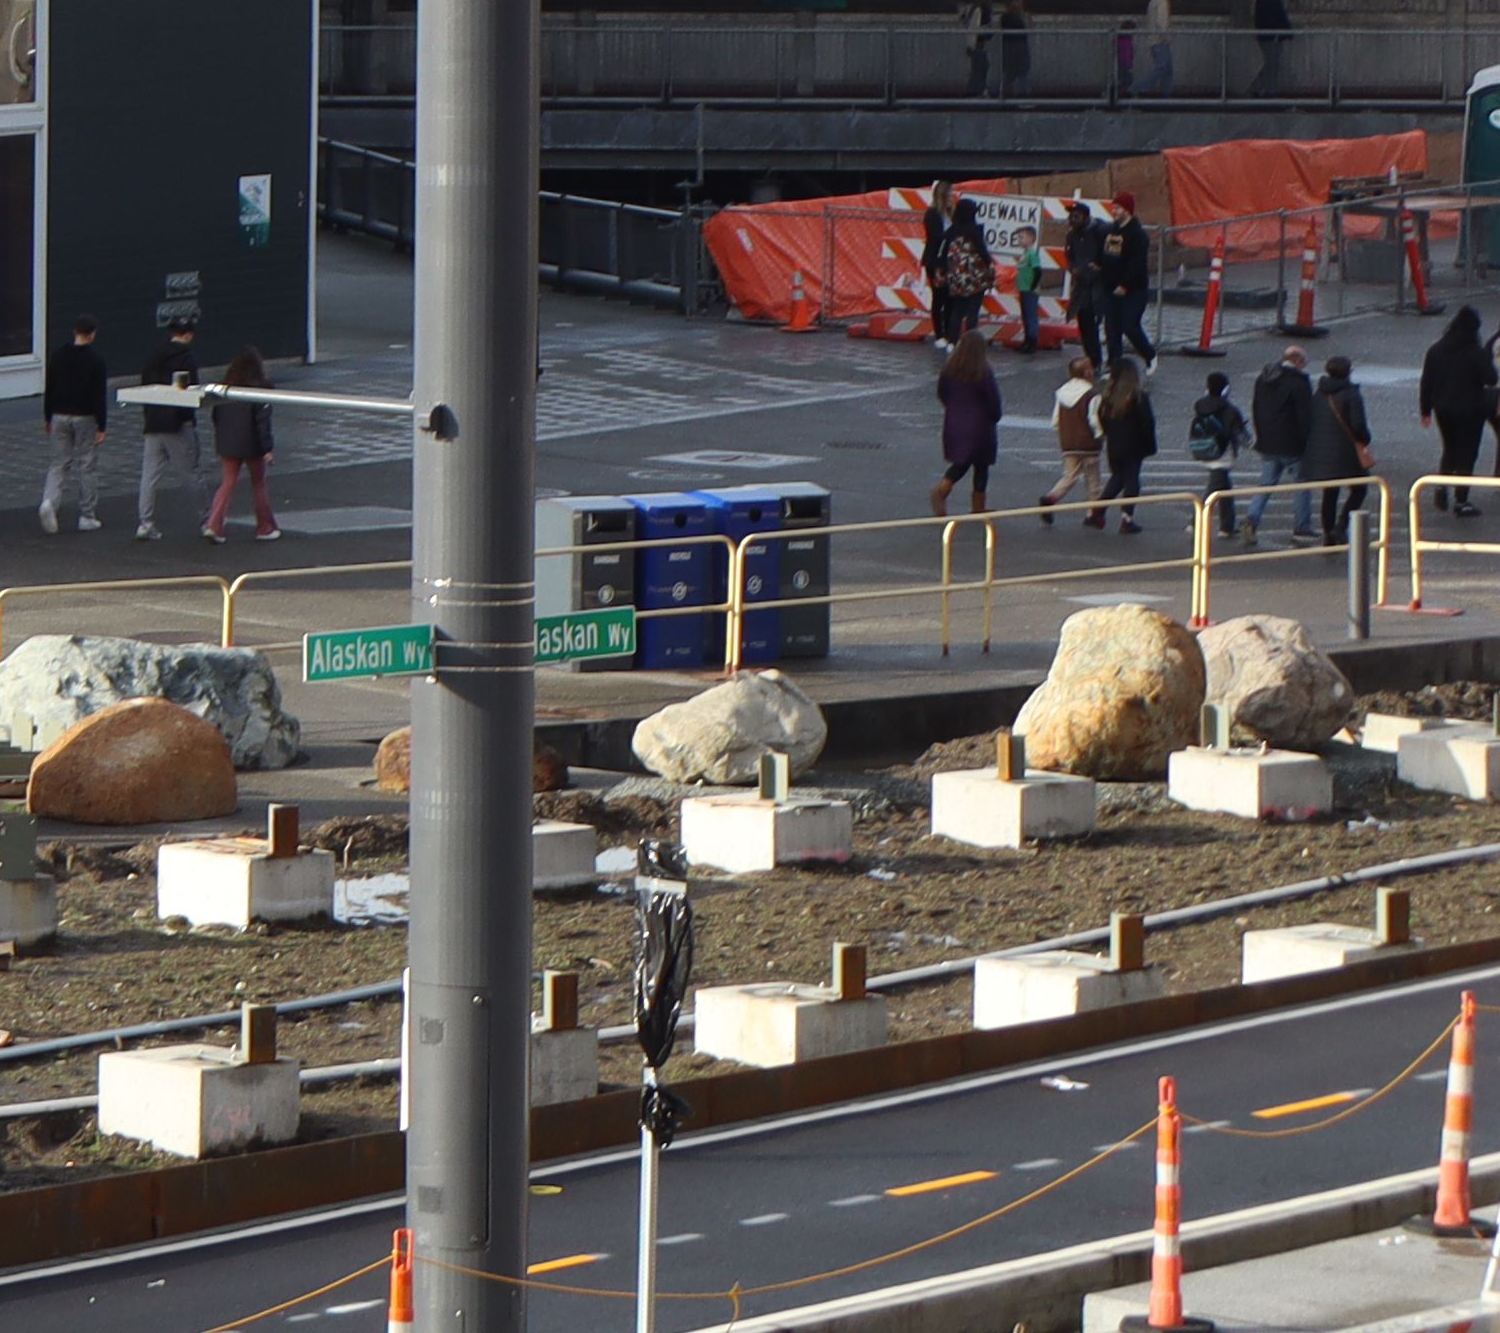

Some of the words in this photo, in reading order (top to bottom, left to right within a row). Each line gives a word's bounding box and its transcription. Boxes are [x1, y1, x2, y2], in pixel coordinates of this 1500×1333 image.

[977, 202, 1038, 224] DEWALK
[311, 635, 393, 674] Alaskan
[403, 640, 426, 670] Wy
[534, 621, 598, 656] laskan
[608, 622, 632, 651] Wy
